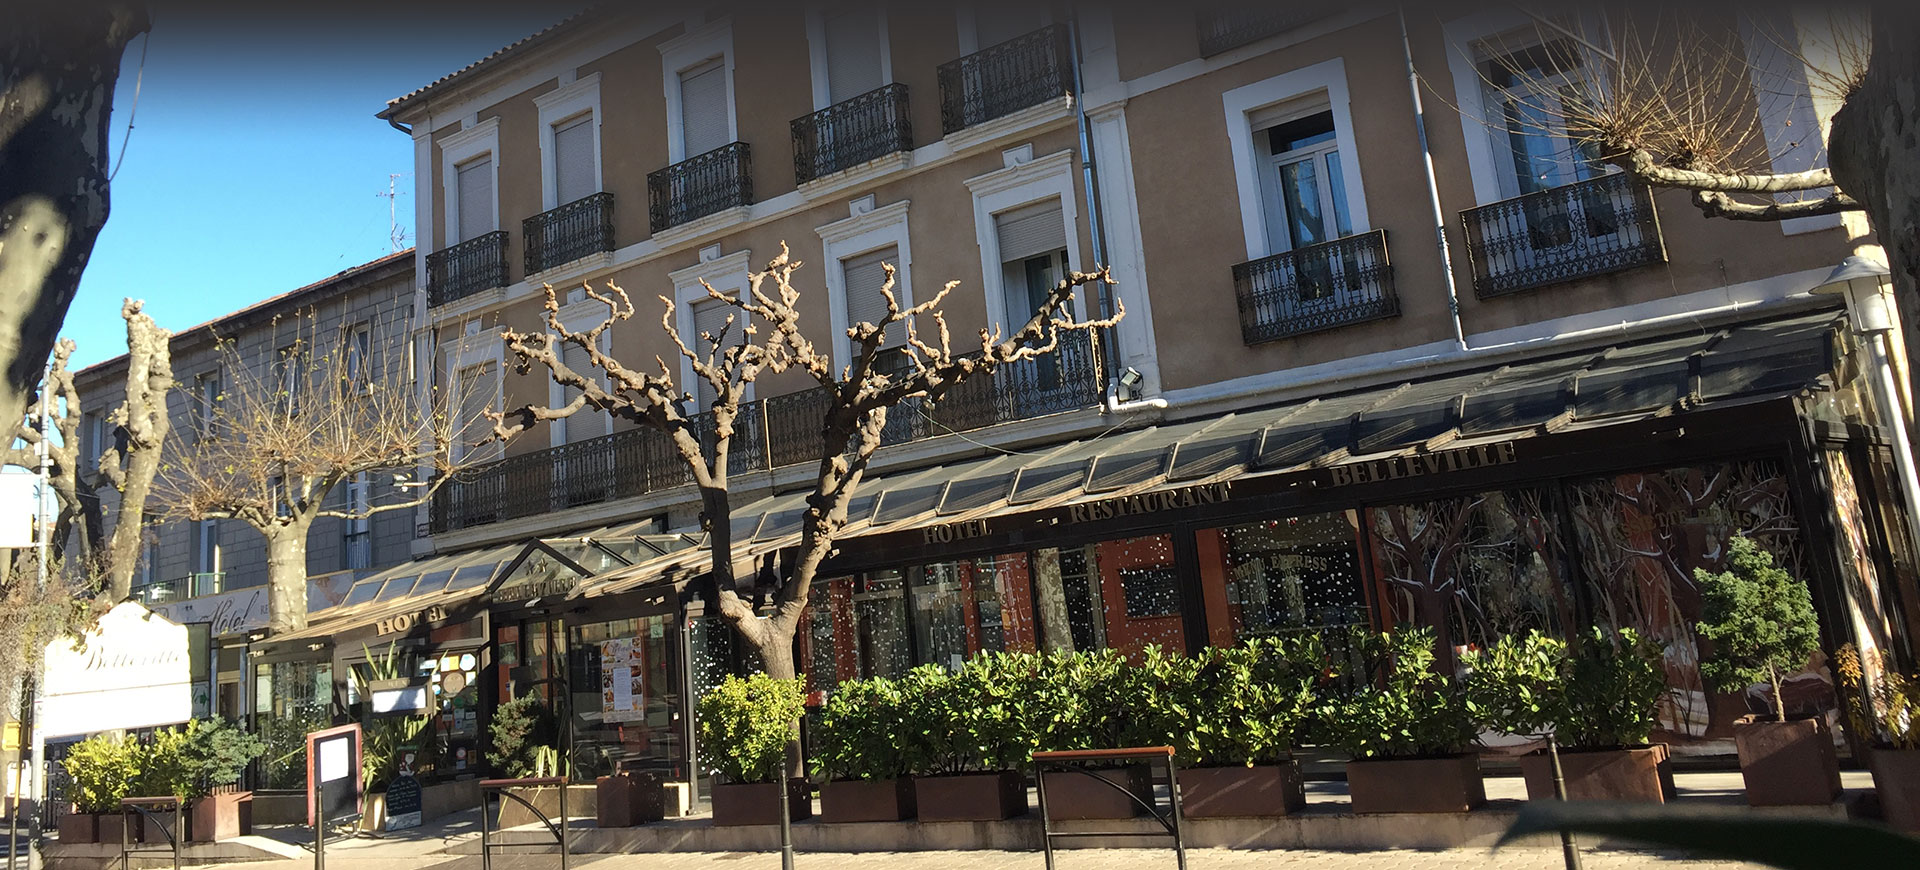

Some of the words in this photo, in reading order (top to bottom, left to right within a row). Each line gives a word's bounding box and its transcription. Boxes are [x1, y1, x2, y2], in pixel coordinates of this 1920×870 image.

[922, 518, 993, 544] HOTEL
[1069, 481, 1232, 523] RESTAURANT
[1329, 441, 1517, 487] BELLEVILLE
[376, 605, 450, 637] HOTEL
